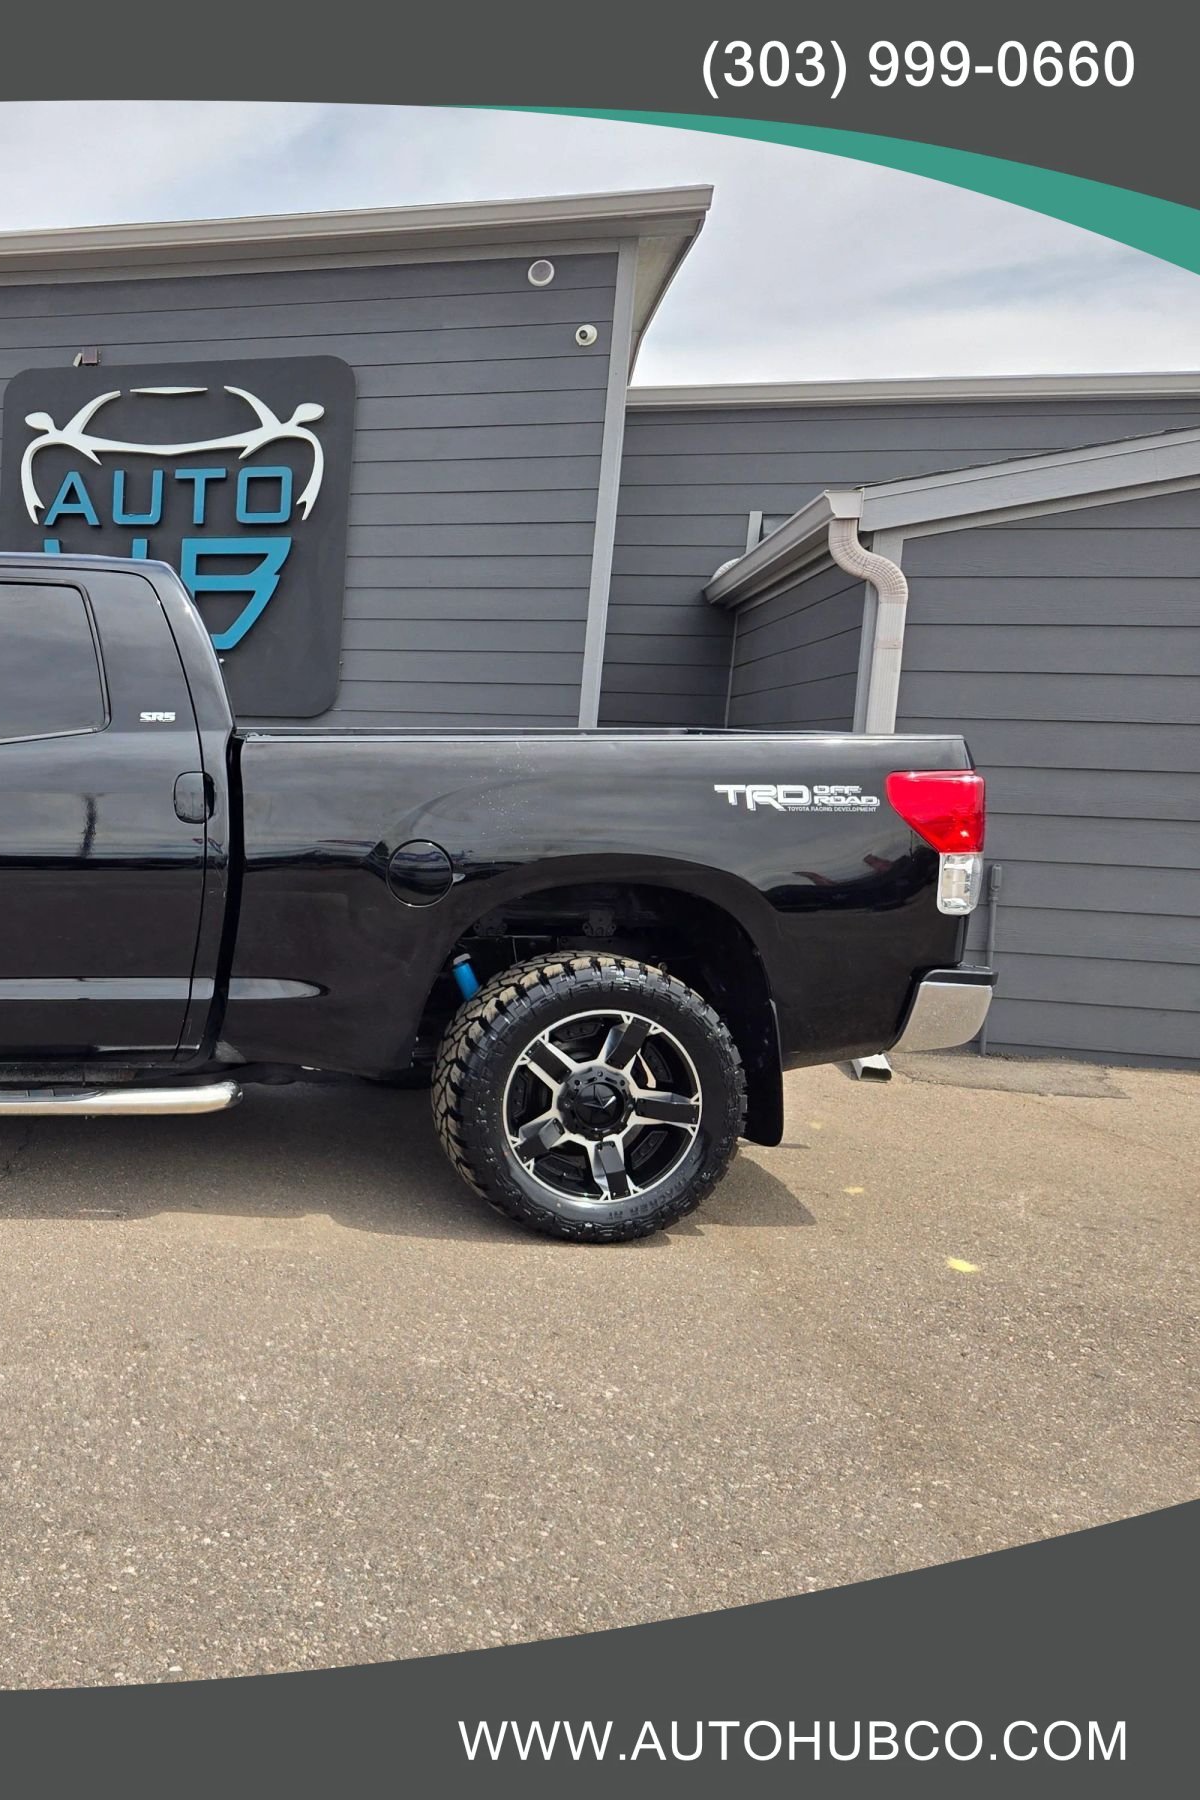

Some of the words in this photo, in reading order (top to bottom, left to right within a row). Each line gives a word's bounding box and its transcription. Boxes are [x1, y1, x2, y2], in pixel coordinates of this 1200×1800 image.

[44, 465, 293, 526] AUTO
[139, 712, 176, 722] SR5
[813, 785, 862, 796] OFF
[714, 784, 812, 812] TRD
[813, 796, 880, 806] ROAD
